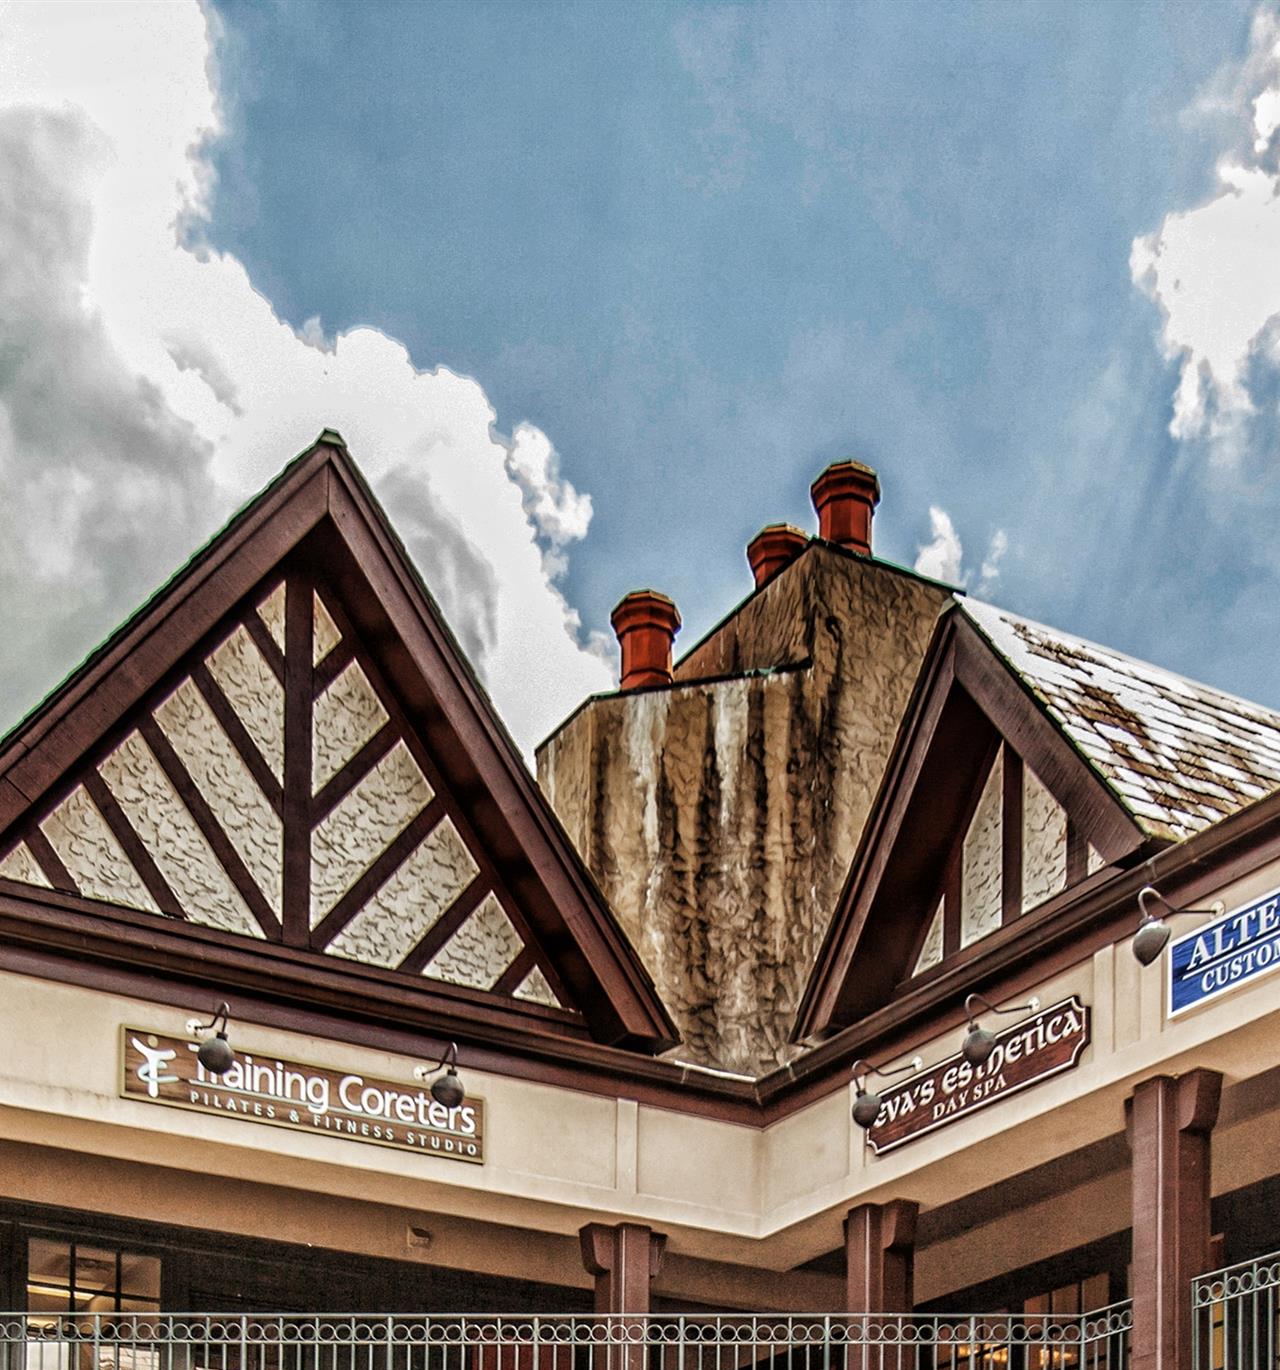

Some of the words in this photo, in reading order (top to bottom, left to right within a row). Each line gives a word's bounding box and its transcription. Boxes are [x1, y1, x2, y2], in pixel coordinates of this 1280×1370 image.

[190, 1090, 276, 1119] PILATES
[289, 1109, 300, 1124] &
[313, 1114, 395, 1141] FITNESS
[407, 1131, 478, 1156] STUDIO
[339, 1075, 476, 1134] Coreters
[933, 1091, 969, 1121] DAY
[973, 1075, 1008, 1102] SPA
